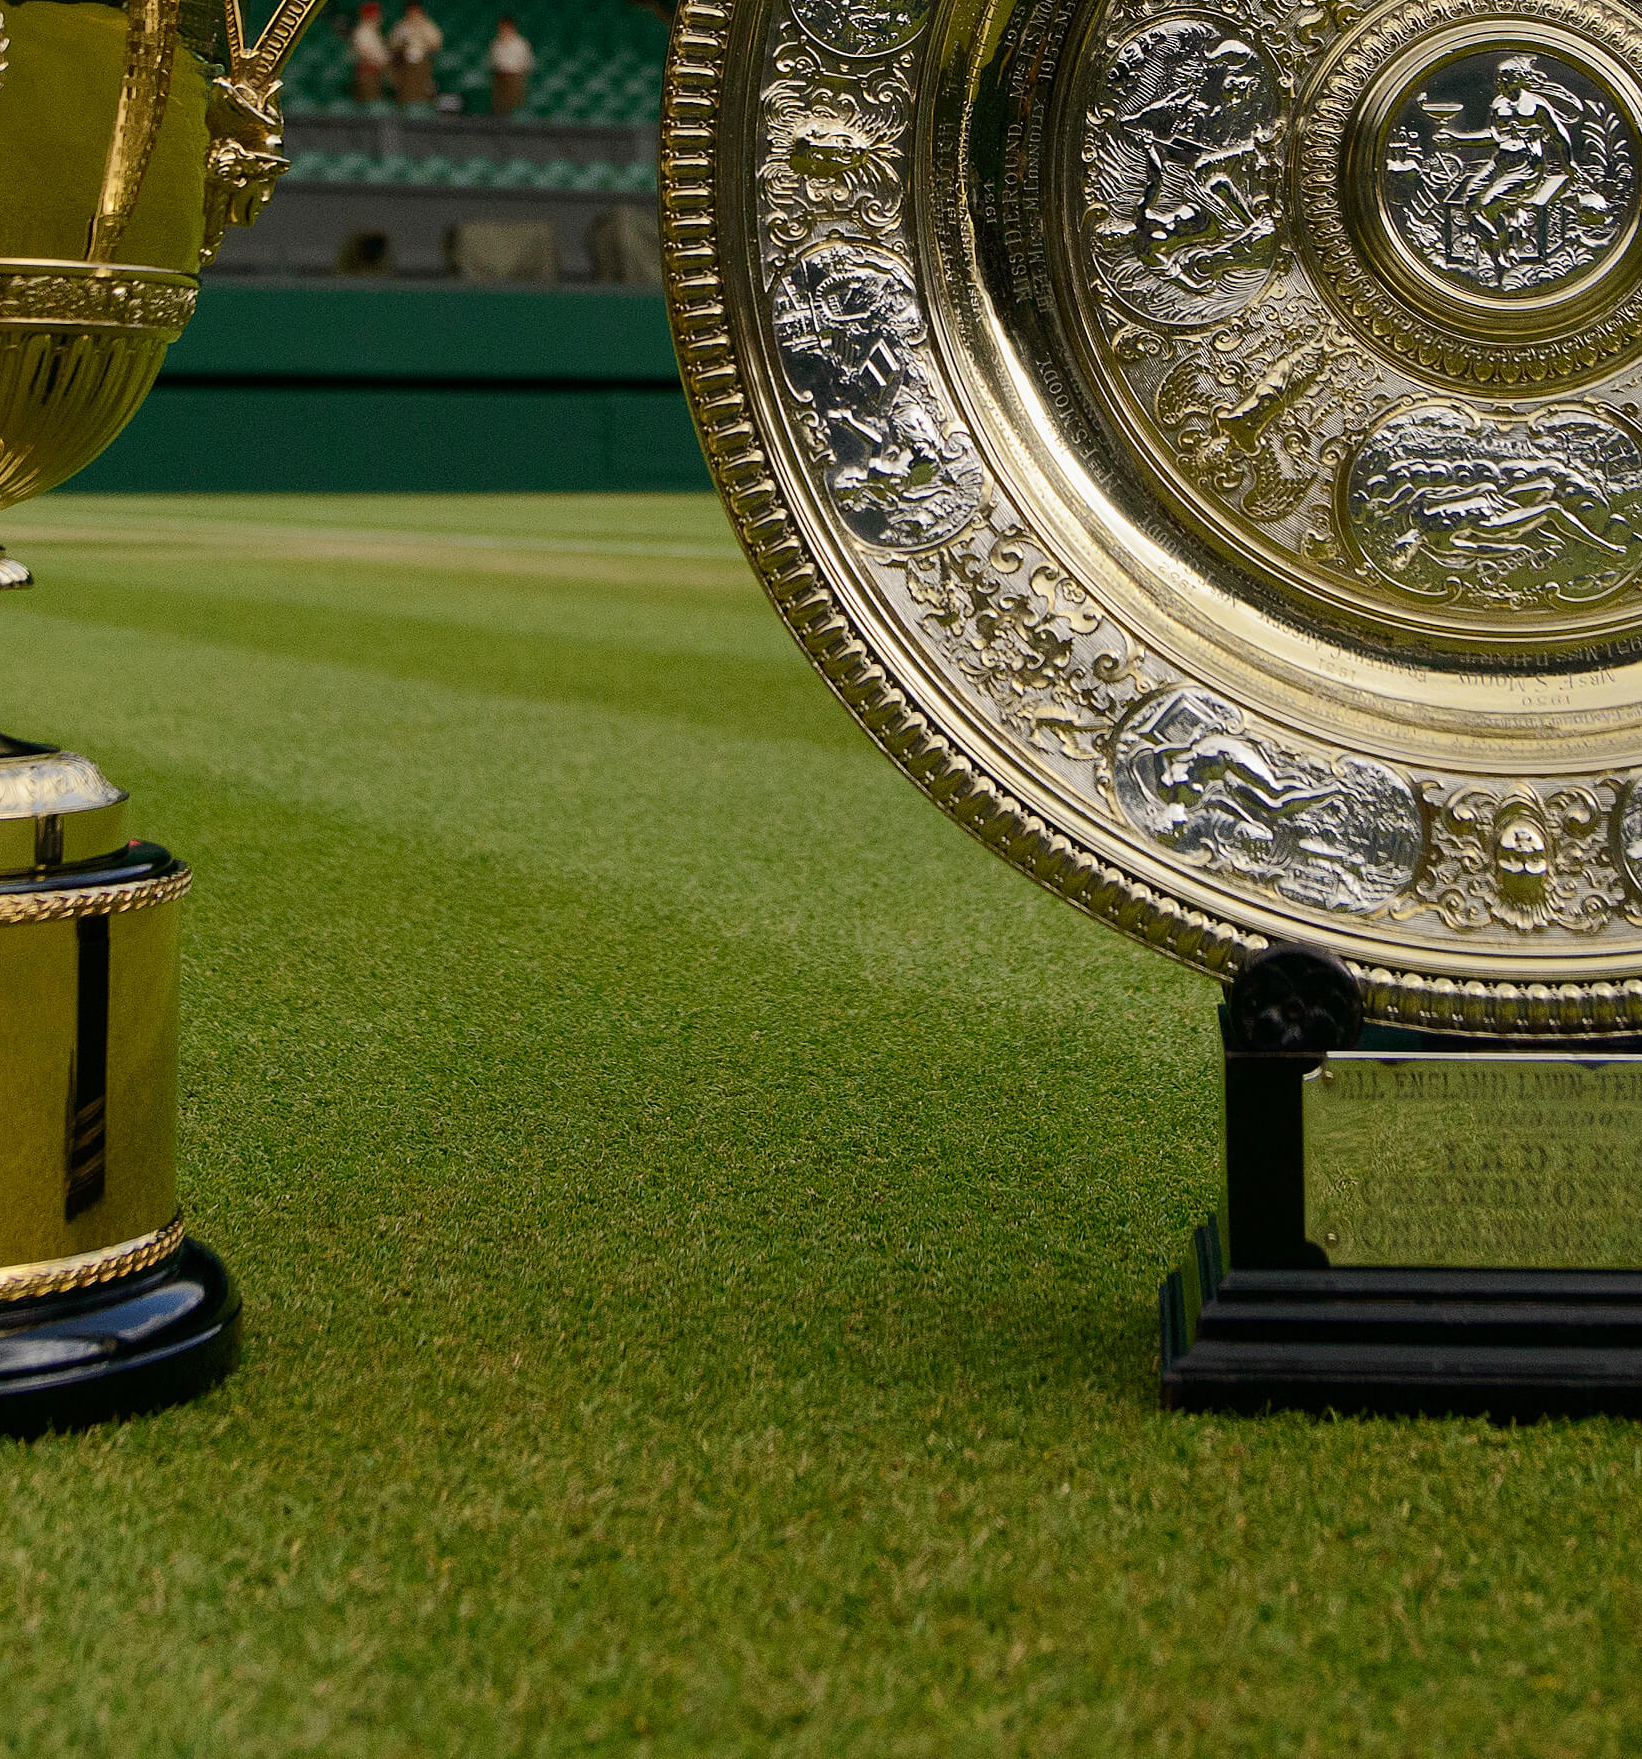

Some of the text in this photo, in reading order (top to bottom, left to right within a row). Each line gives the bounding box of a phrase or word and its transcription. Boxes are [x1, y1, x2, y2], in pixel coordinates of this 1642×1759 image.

[1002, 1, 1028, 49] 1935
[1008, 58, 1035, 100] MRS
[983, 180, 998, 225] 1934
[1006, 250, 1034, 304] MISS
